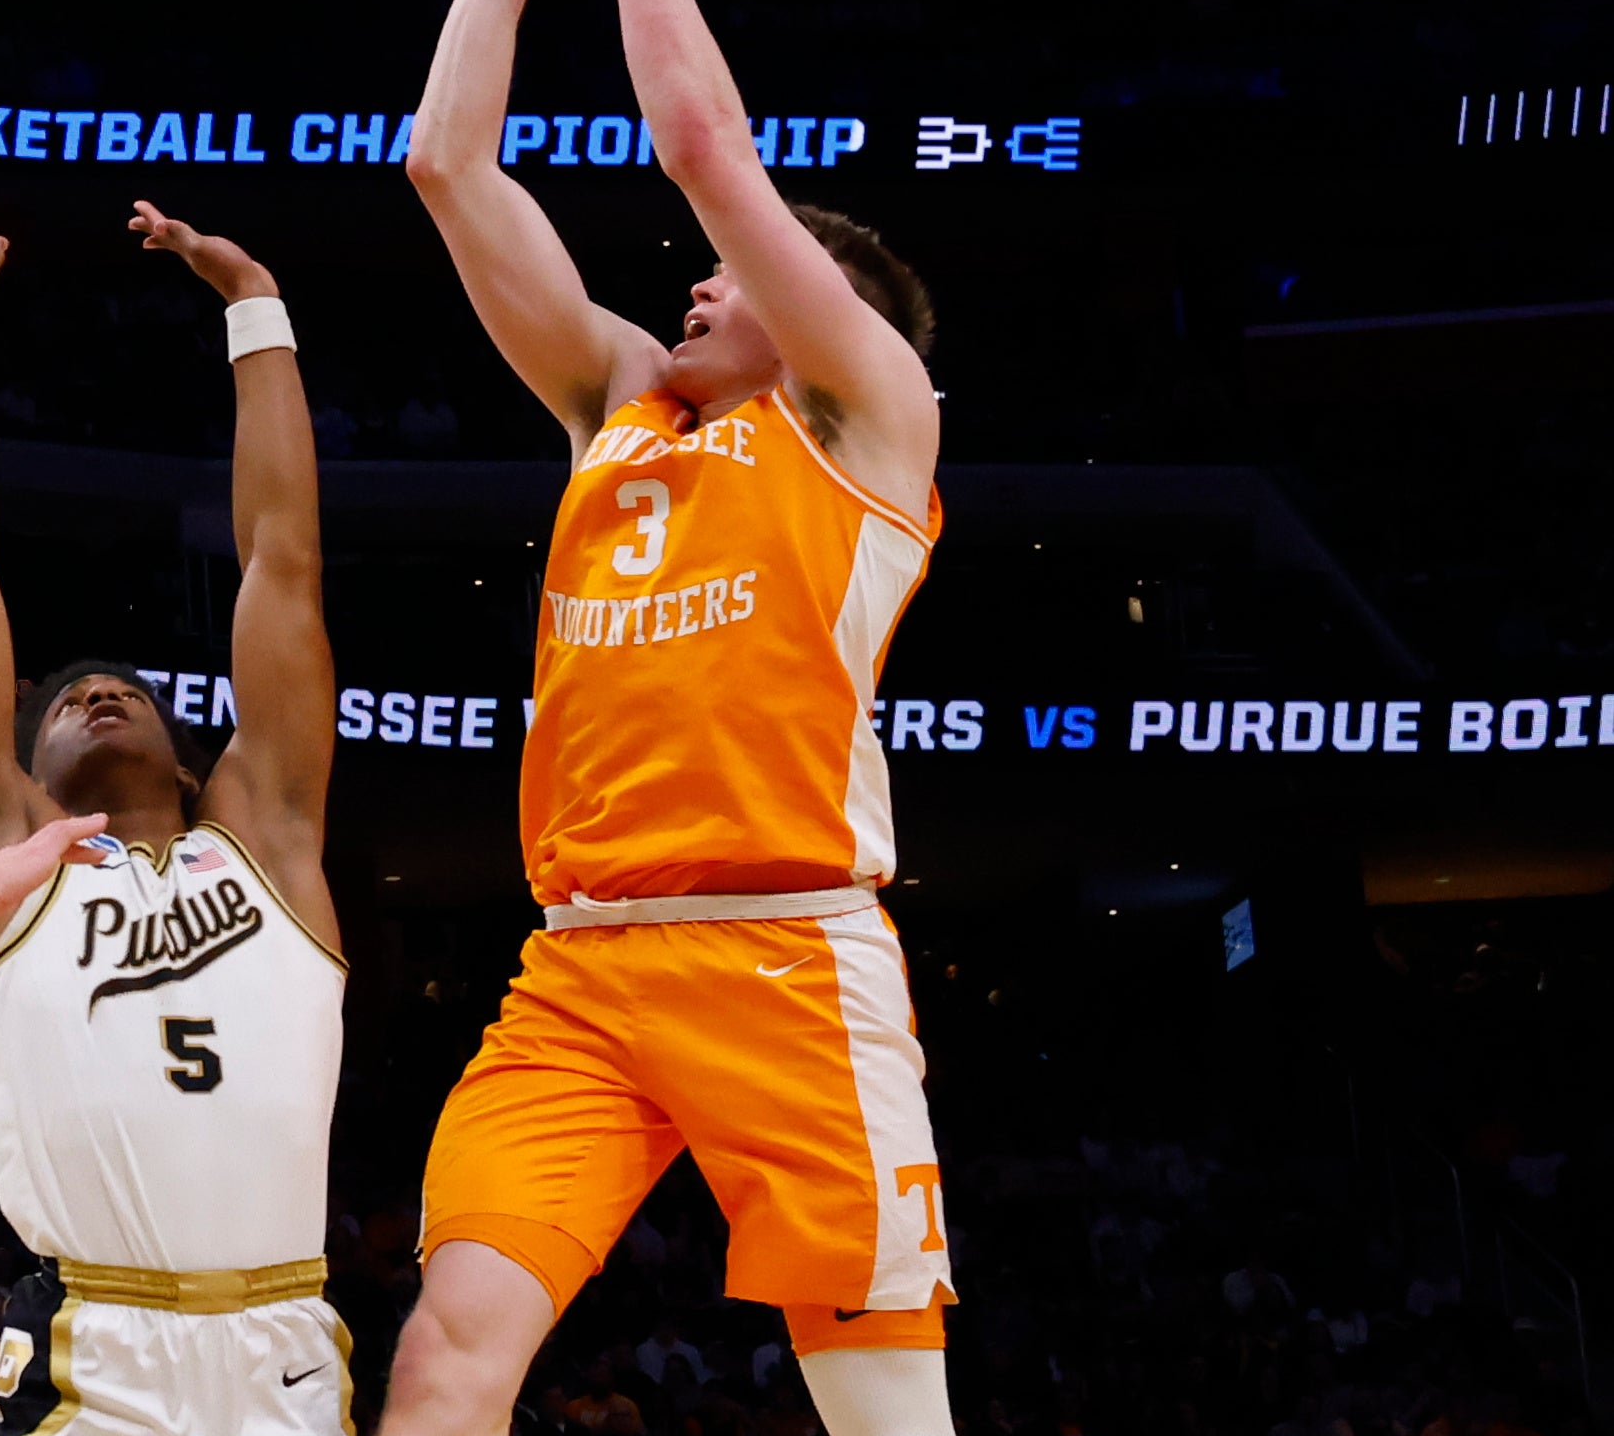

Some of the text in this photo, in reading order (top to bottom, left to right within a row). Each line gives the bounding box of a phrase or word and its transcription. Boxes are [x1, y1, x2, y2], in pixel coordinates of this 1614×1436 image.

[611, 478, 670, 576] 3
[1024, 703, 1097, 750] VS
[1128, 699, 1422, 753] PURDUE
[160, 1017, 221, 1092] 5
